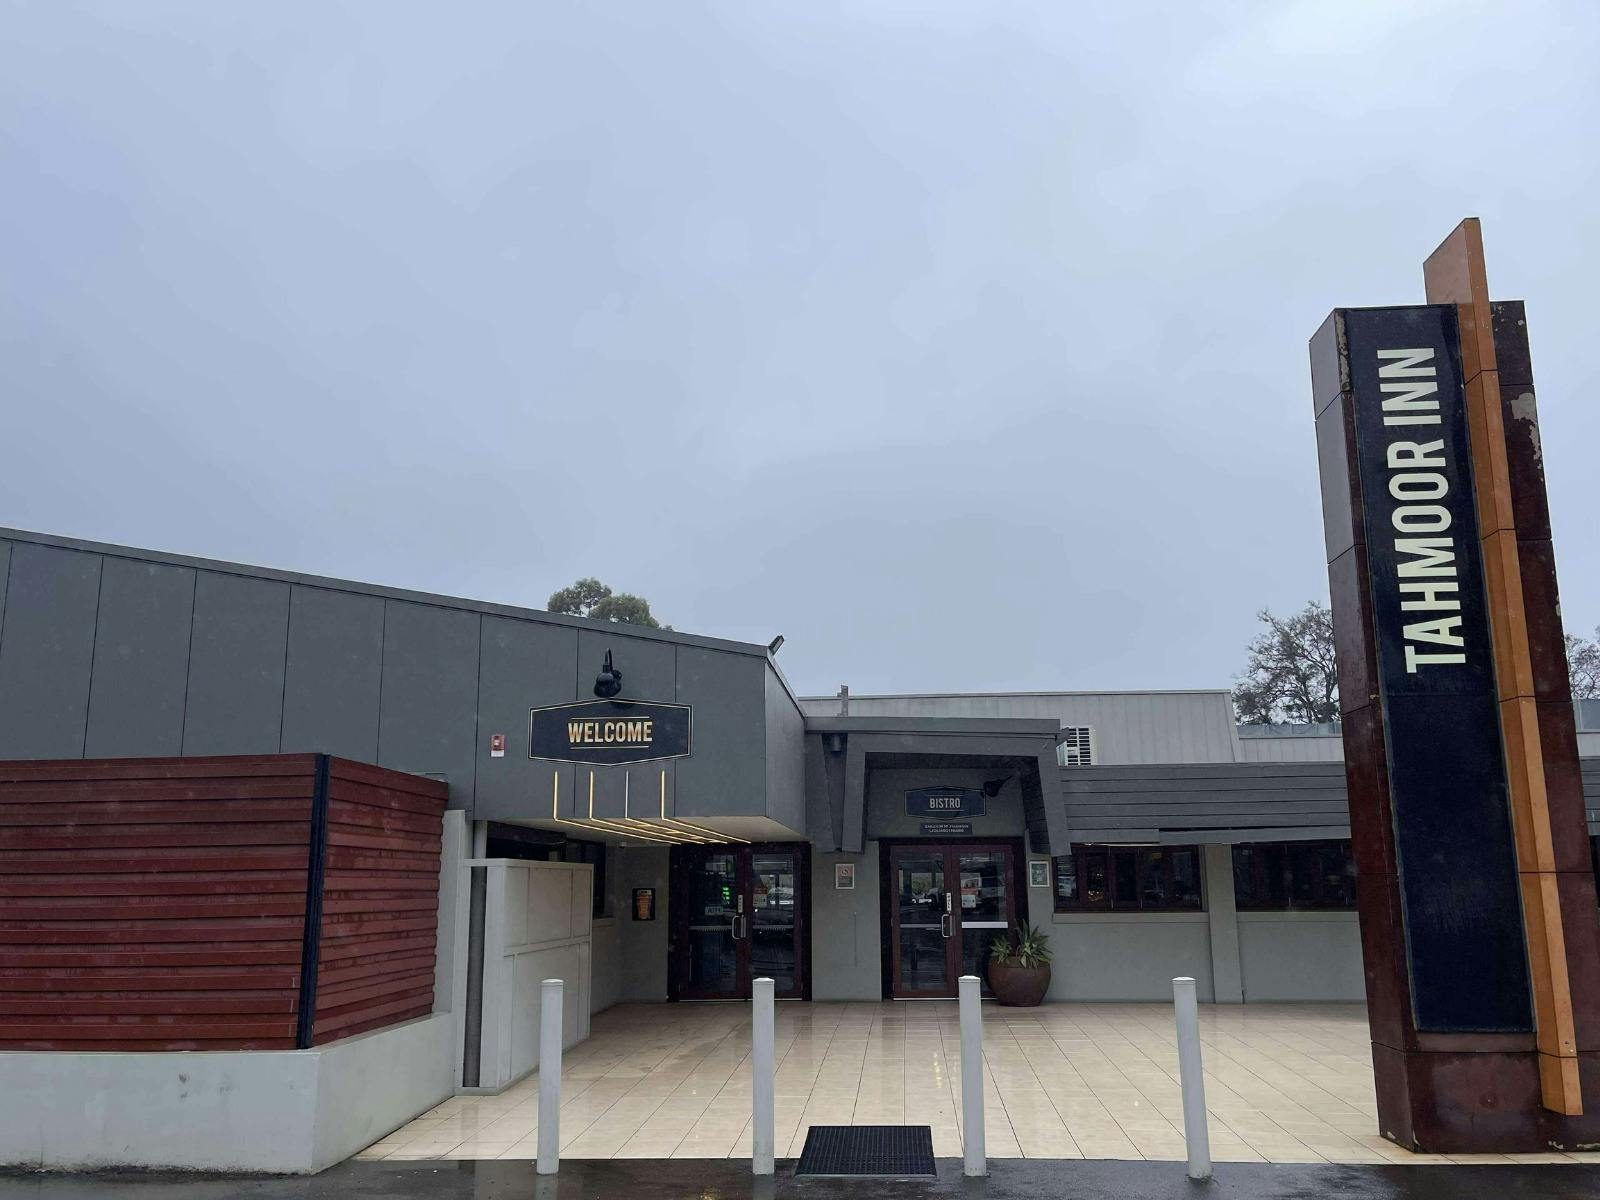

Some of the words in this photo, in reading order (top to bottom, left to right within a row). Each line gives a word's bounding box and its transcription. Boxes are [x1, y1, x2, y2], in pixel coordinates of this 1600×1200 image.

[1377, 348, 1442, 426] INN
[1387, 439, 1465, 673] TAHMOOR
[568, 721, 653, 743] WELCOME
[929, 798, 961, 809] BISTRO
